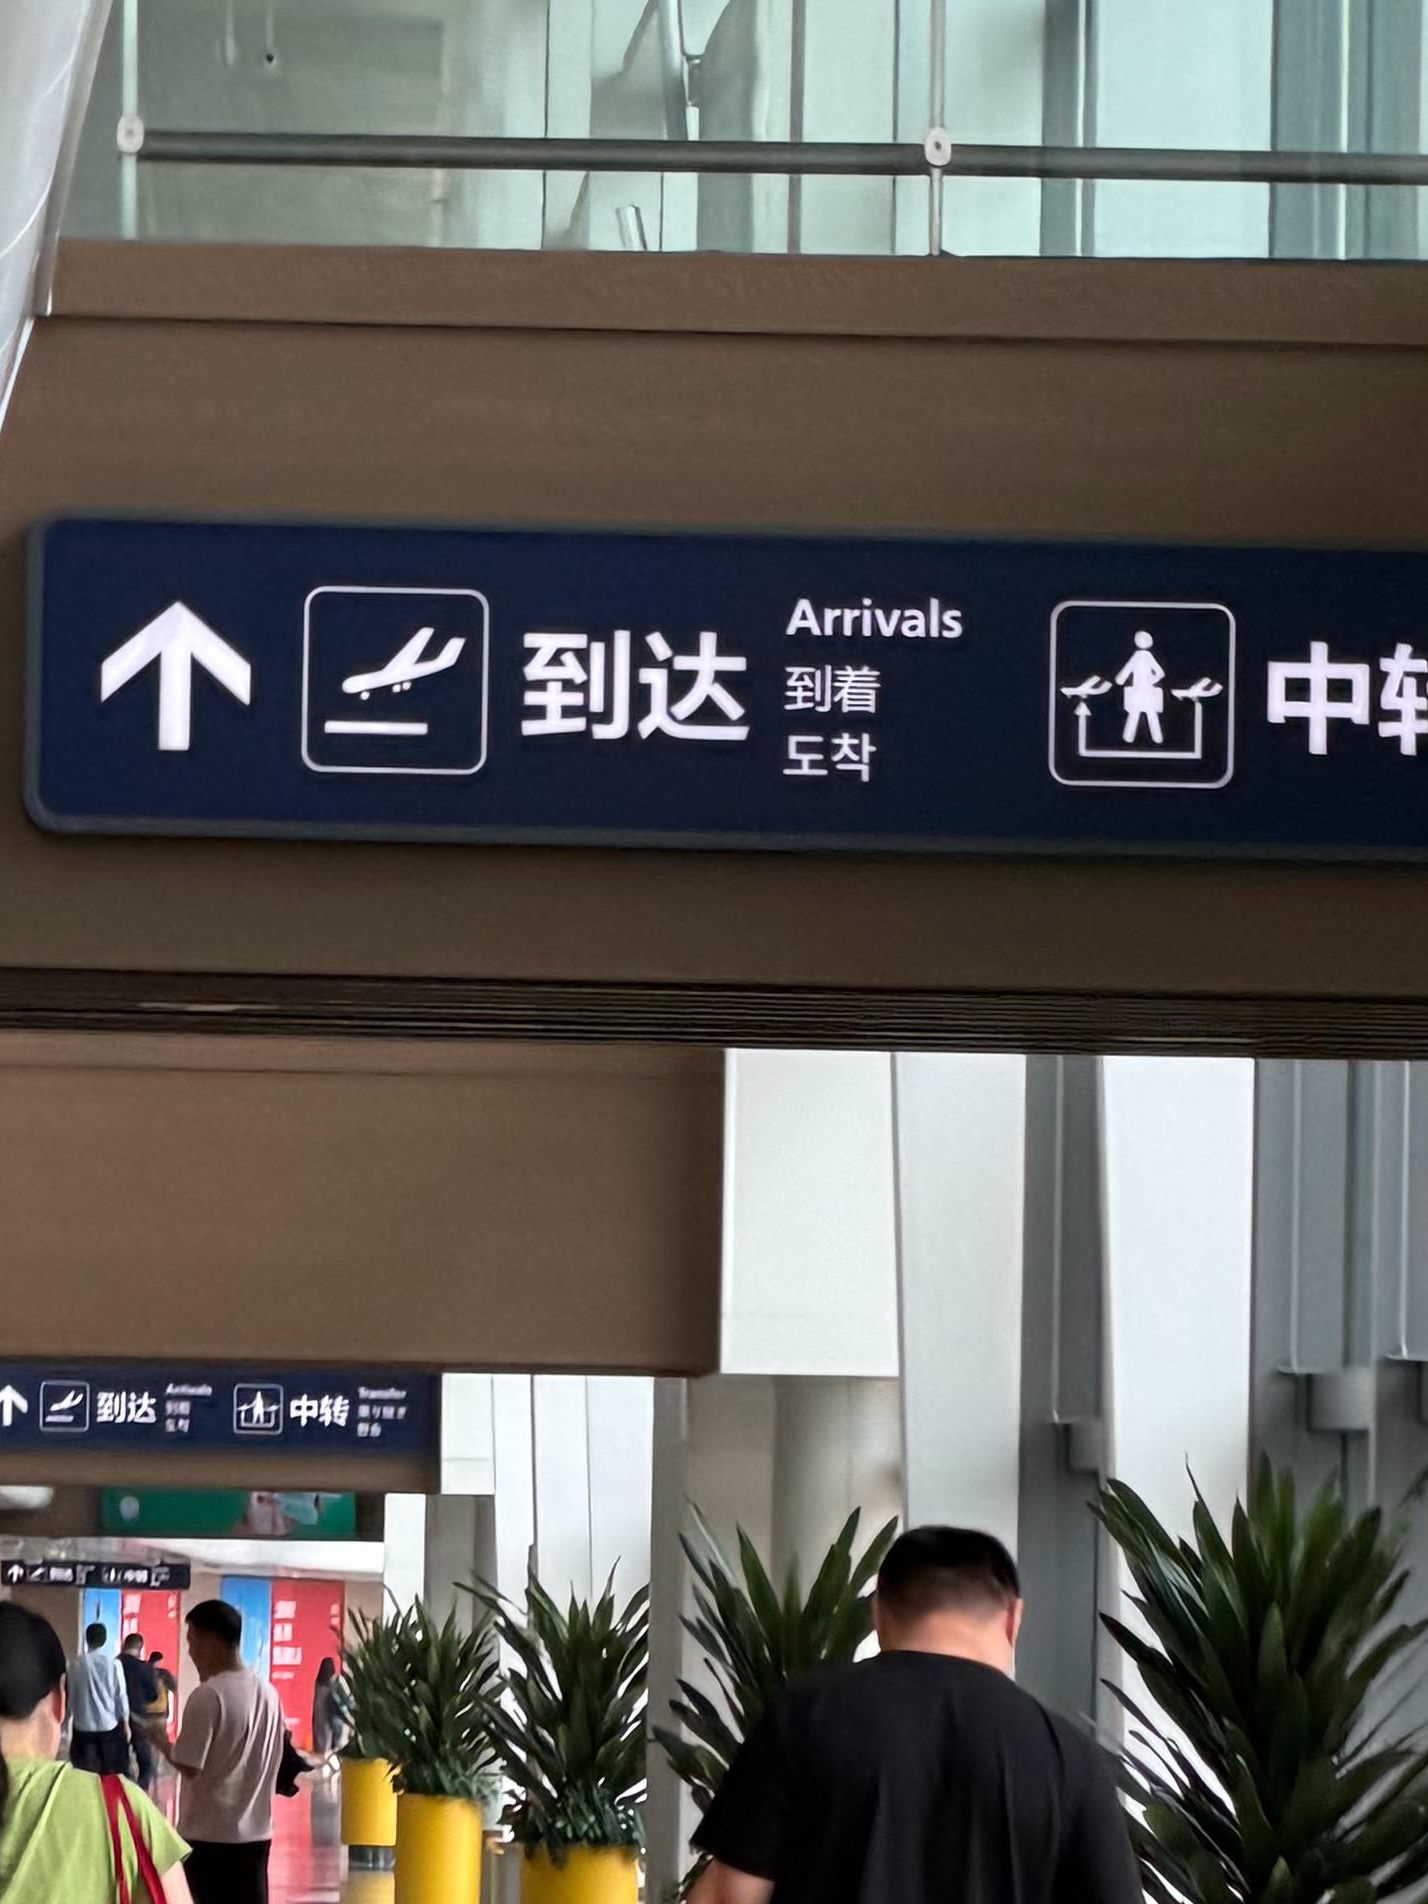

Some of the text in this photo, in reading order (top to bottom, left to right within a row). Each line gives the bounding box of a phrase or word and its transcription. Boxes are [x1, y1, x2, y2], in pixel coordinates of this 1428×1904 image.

[786, 597, 964, 639] Arrivals
[521, 630, 750, 741] 到达
[783, 664, 881, 714] 到着
[783, 733, 877, 782] 도착
[96, 1390, 157, 1424] 到达
[289, 1393, 350, 1428] 中转
